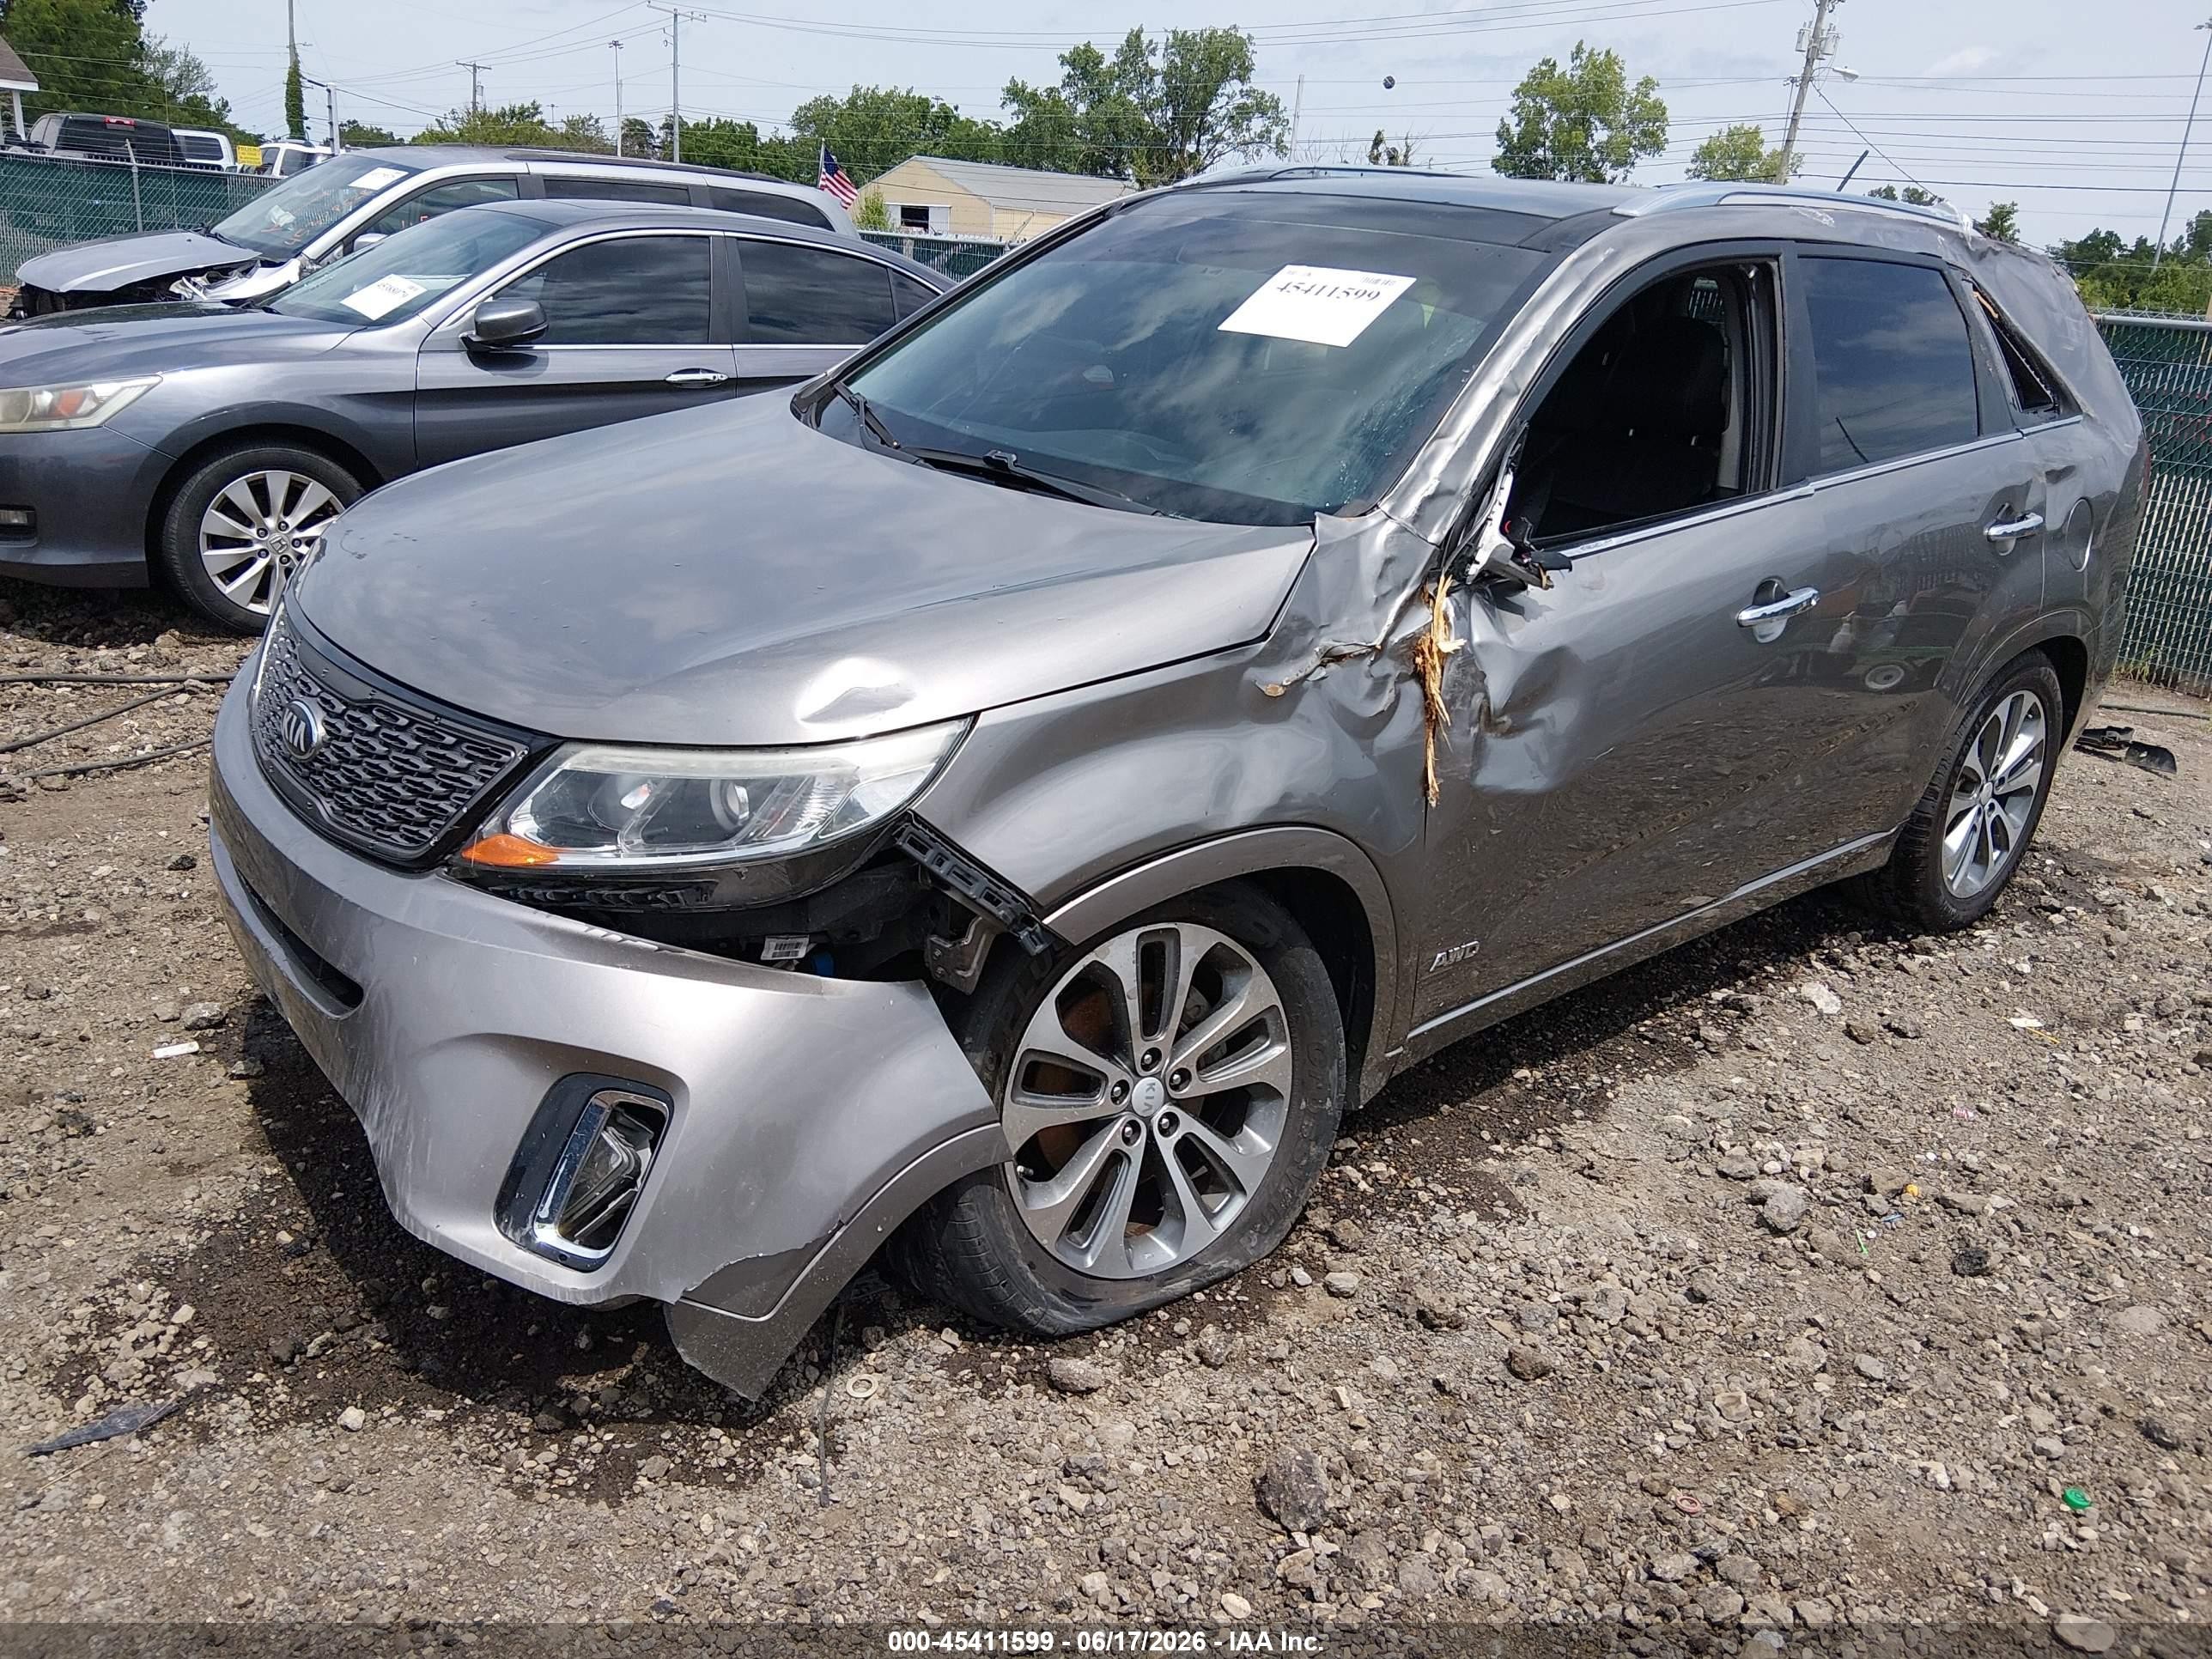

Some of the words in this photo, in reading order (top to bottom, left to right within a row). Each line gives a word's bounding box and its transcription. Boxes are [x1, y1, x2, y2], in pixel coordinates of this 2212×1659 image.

[1276, 280, 1382, 301] 45411599
[1429, 940, 1480, 972] AWD
[1141, 1082, 1157, 1114] KIA
